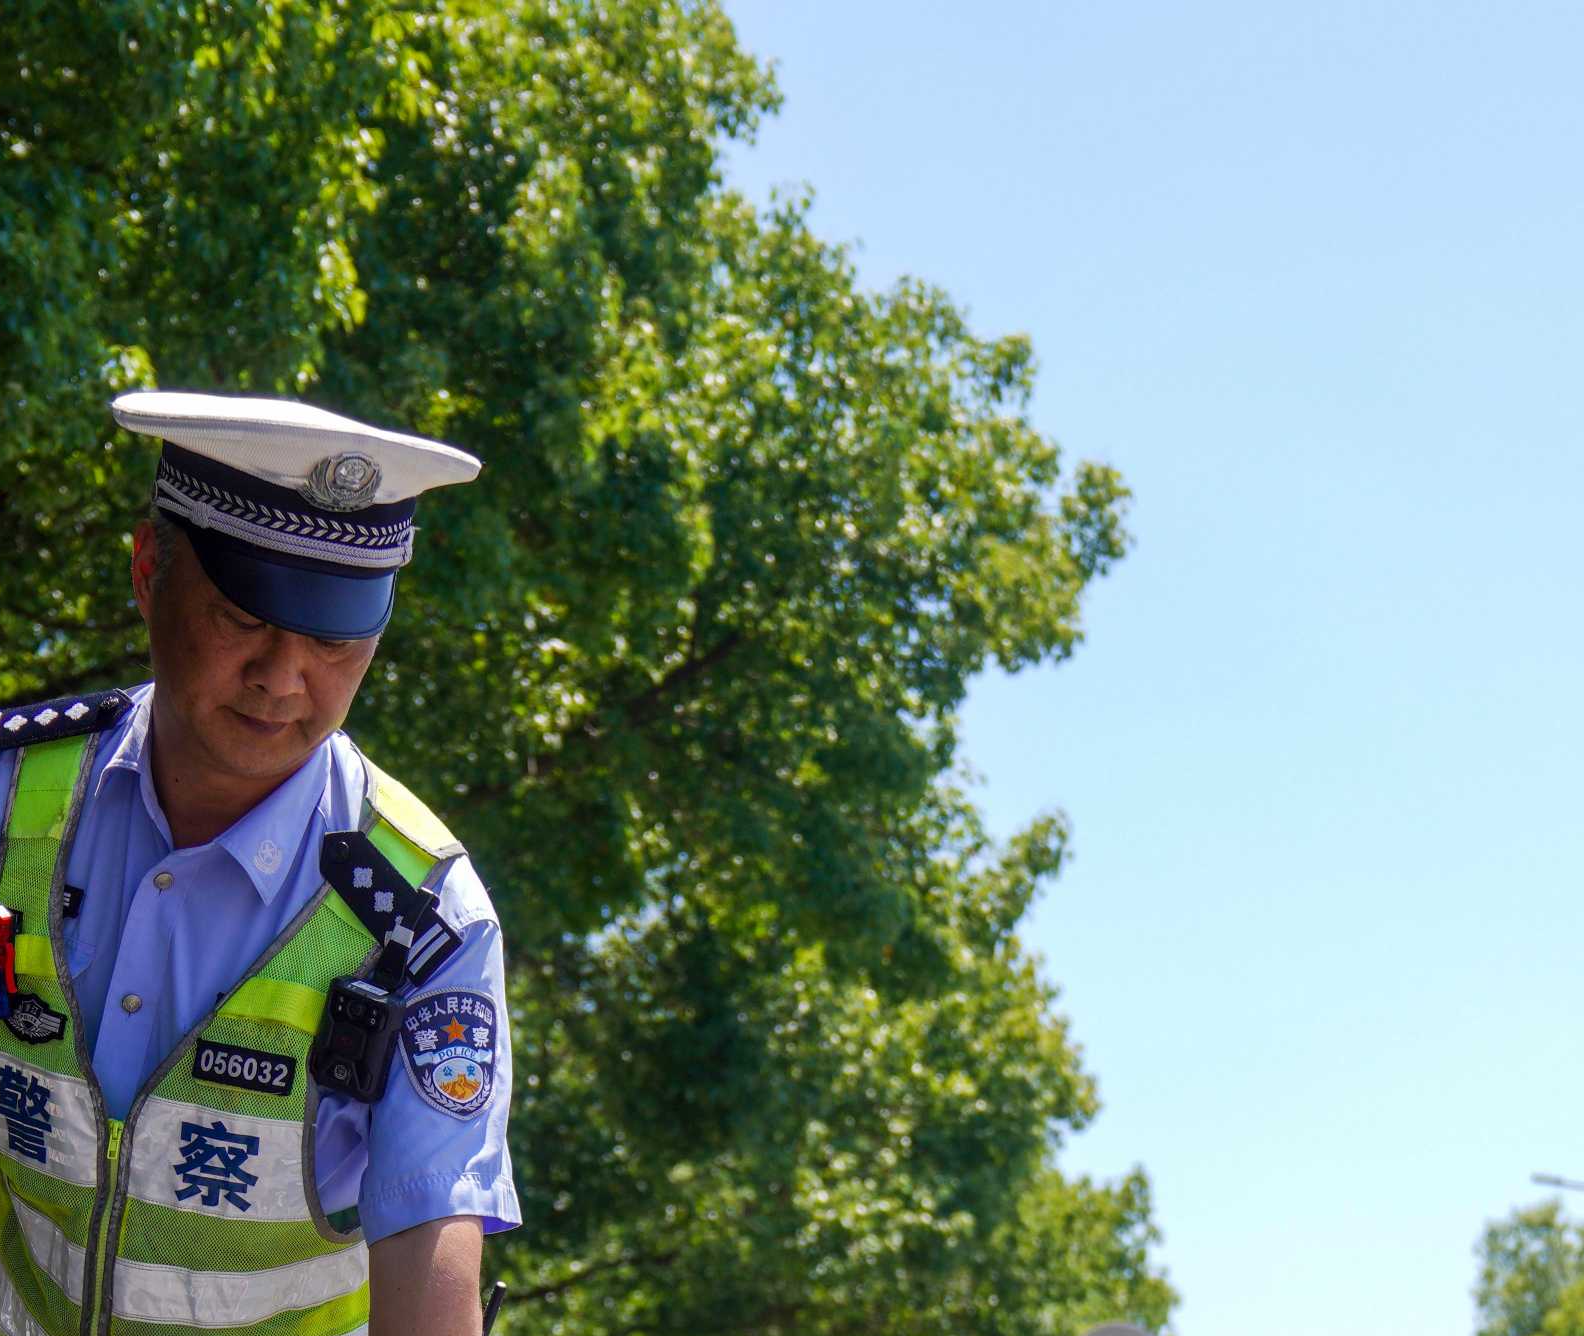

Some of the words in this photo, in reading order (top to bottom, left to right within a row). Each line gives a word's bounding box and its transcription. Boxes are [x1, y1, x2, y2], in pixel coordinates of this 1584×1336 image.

[406, 997, 493, 1031] 中华人民共和国
[200, 1048, 289, 1088] 056032
[438, 1048, 476, 1060] POLICE
